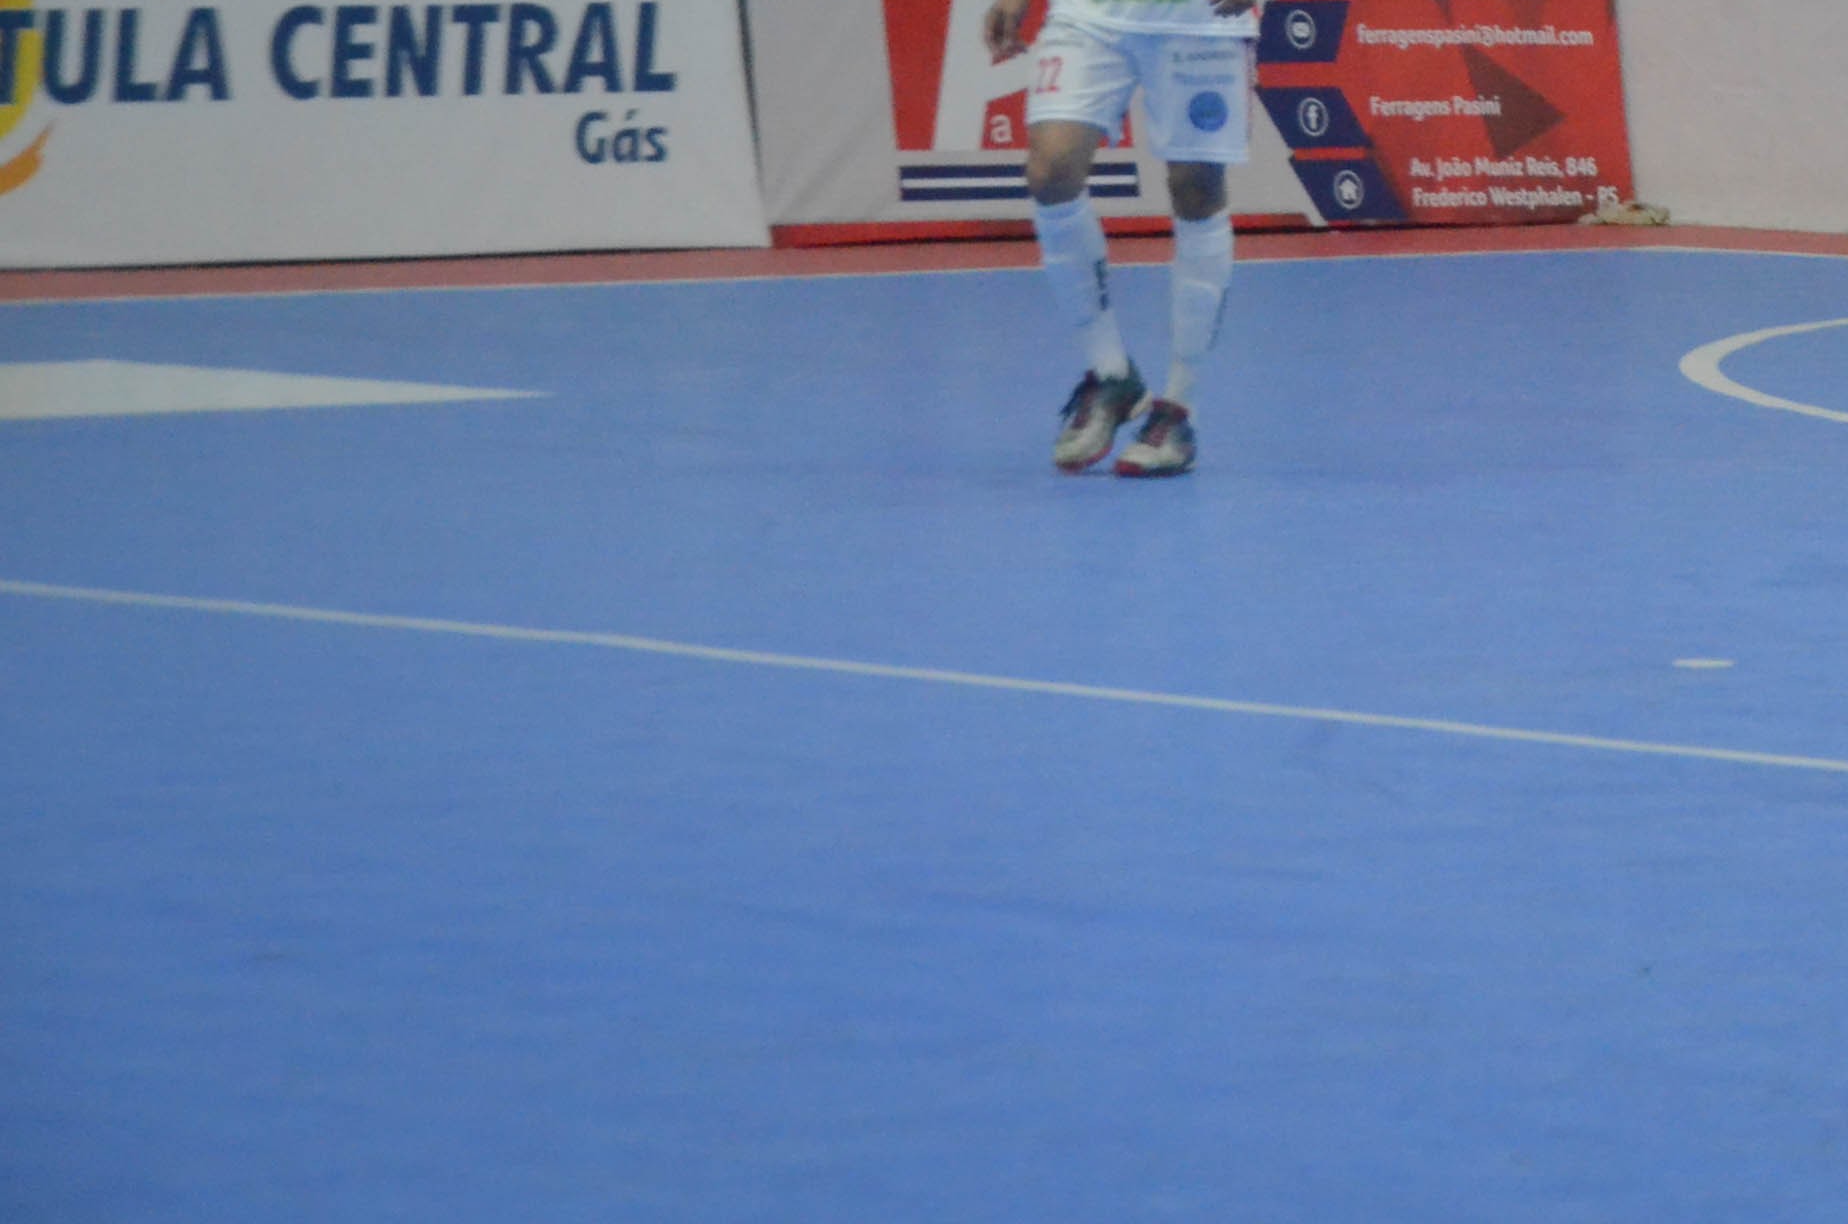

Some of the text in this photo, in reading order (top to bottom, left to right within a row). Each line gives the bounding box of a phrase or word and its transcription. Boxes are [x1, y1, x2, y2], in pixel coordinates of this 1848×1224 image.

[270, 1, 677, 101] CENTRAL
[1369, 95, 1502, 122] Ferragens Pasini
[575, 108, 669, 165] Gás
[1436, 156, 1473, 182] João
[1474, 157, 1524, 177] Muniz
[1412, 186, 1488, 208] Frederico
[1488, 185, 1583, 210] Westphalen
